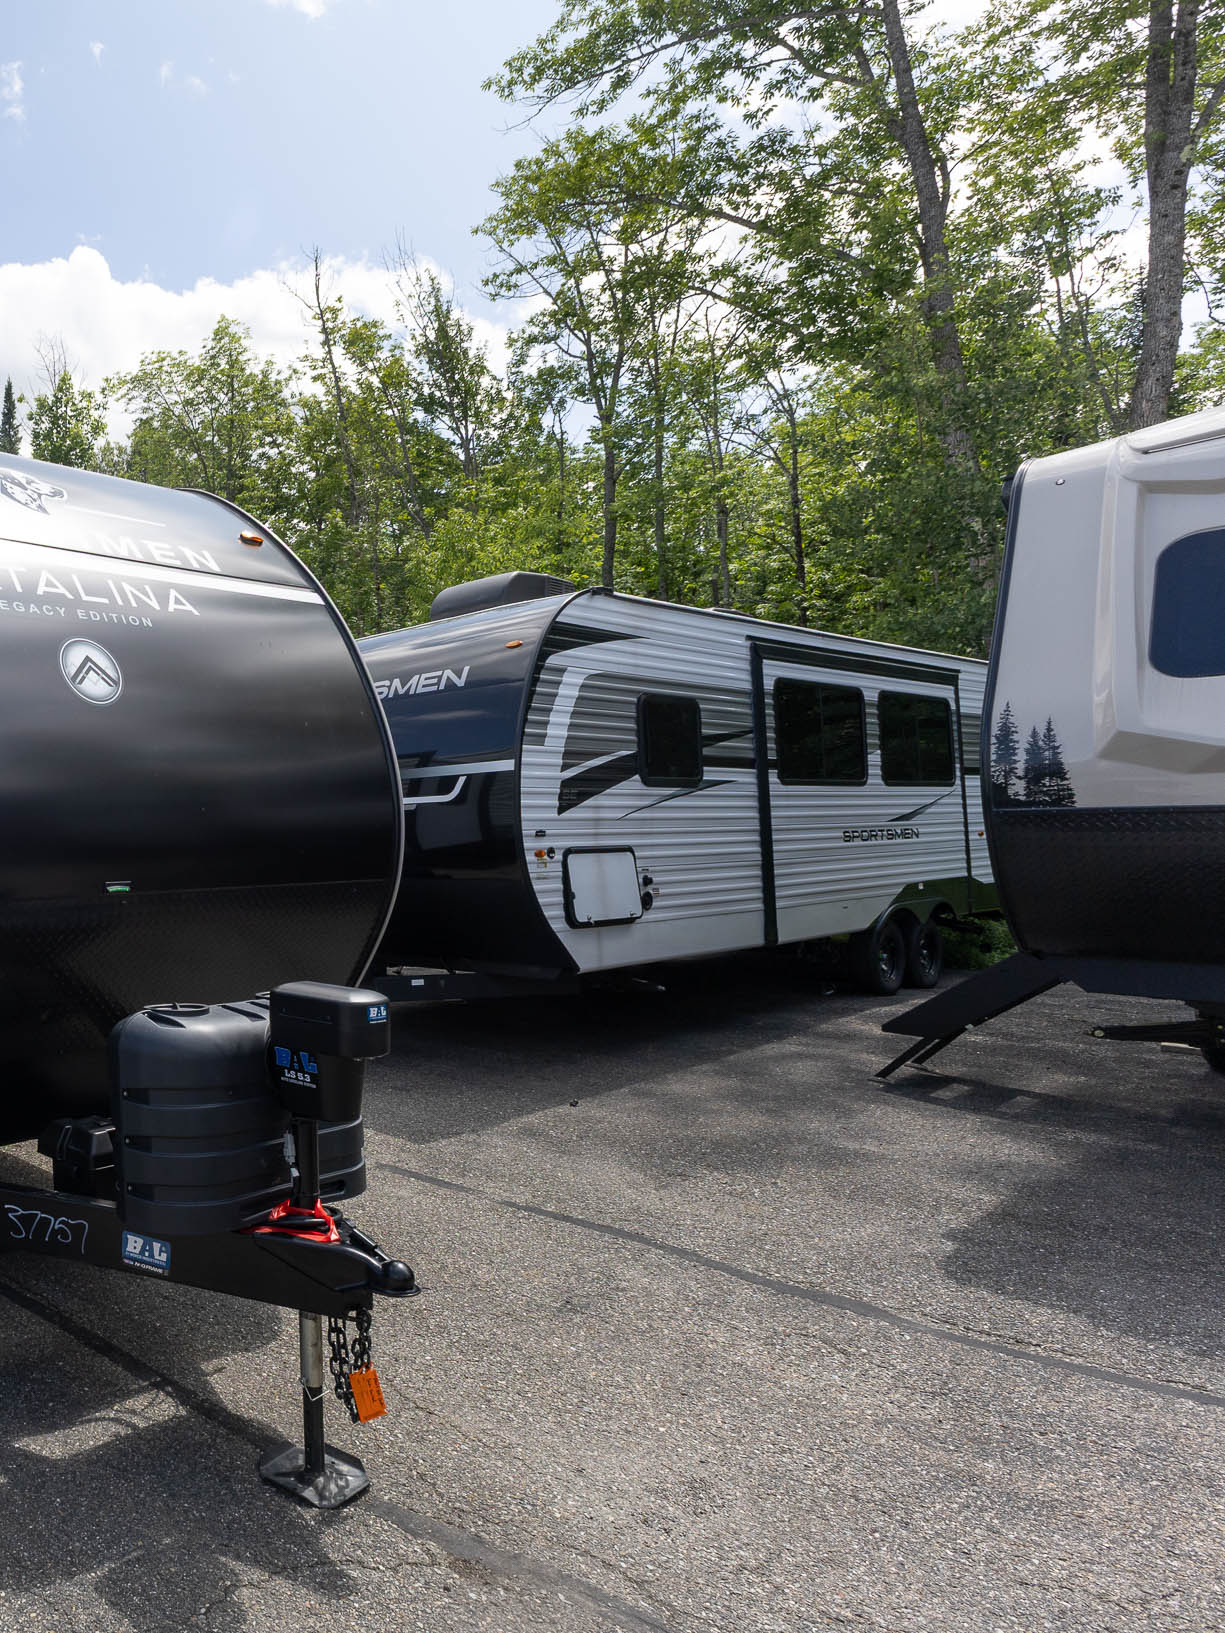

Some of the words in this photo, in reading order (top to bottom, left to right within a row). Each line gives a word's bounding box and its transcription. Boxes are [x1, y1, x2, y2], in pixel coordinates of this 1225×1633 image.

[77, 608, 154, 628] EDITION
[842, 827, 920, 843] SPORTSMEN
[4, 1204, 88, 1255] 37757
